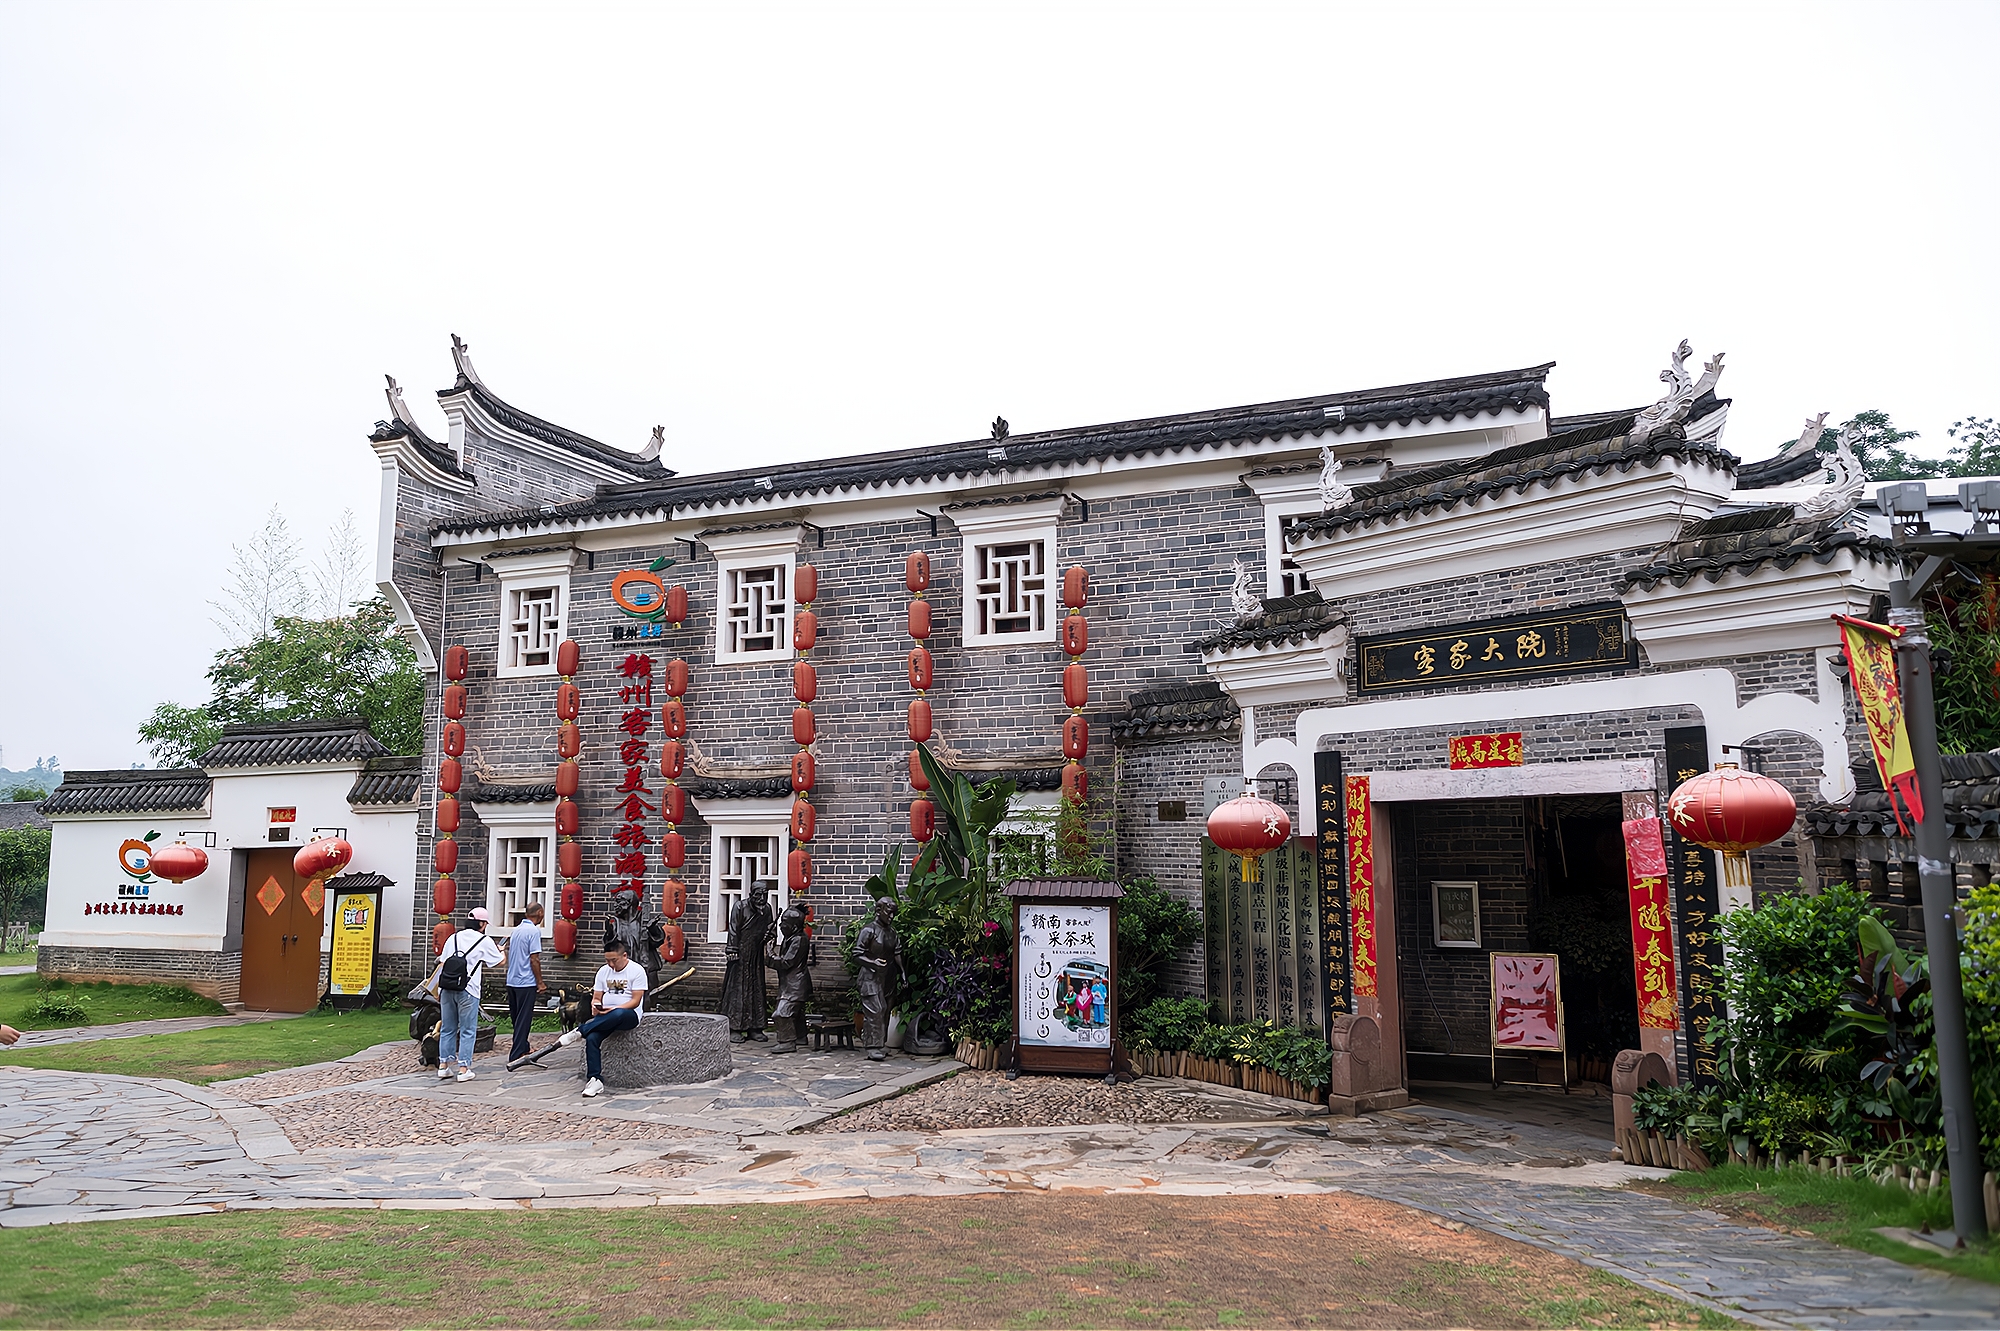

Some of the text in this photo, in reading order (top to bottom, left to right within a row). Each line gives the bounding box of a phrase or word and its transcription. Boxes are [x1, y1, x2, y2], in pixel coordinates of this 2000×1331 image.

[1413, 630, 1546, 675] 客家大院
[1261, 813, 1281, 838] 宋
[1032, 914, 1061, 930] 赣南
[1207, 845, 1222, 1022] 江南宋城餐饮文化研究基
[1048, 931, 1096, 948] 采茶戏
